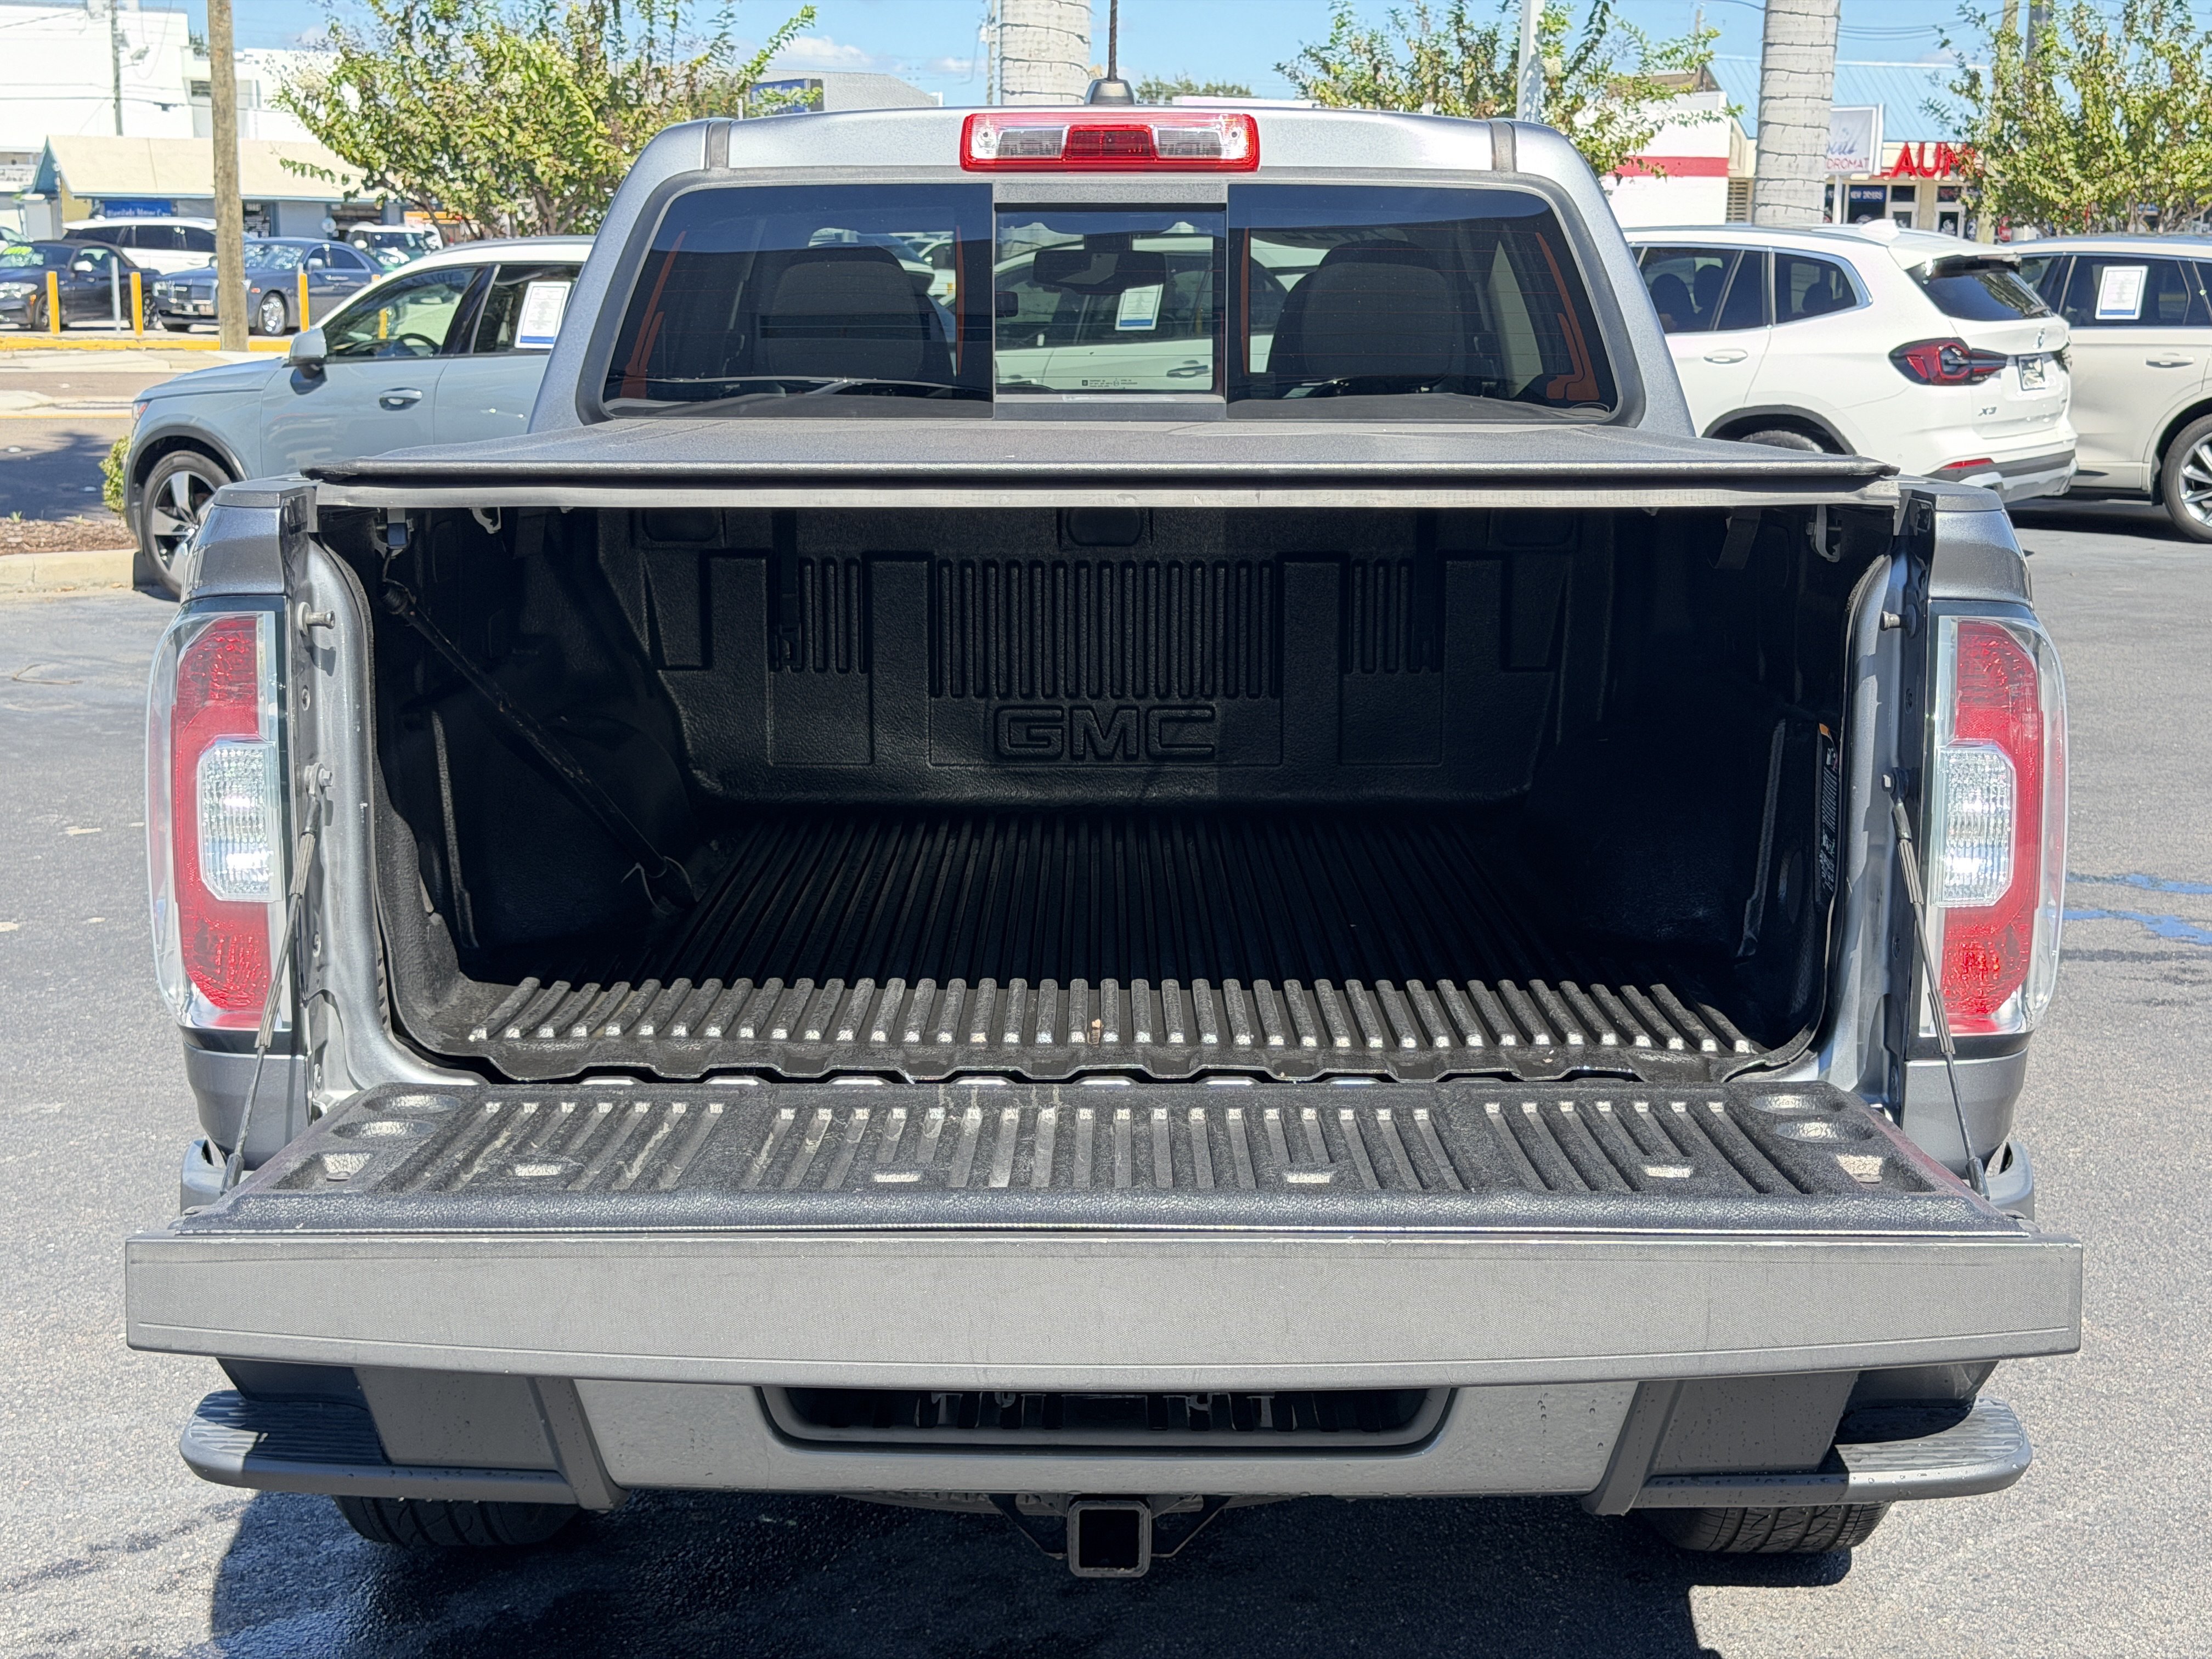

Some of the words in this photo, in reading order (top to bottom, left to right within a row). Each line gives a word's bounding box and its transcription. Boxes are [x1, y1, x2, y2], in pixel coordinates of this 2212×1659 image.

[1826, 157, 1869, 170] DROMAT
[1978, 406, 1997, 417] X3
[993, 704, 1216, 760] GMC
